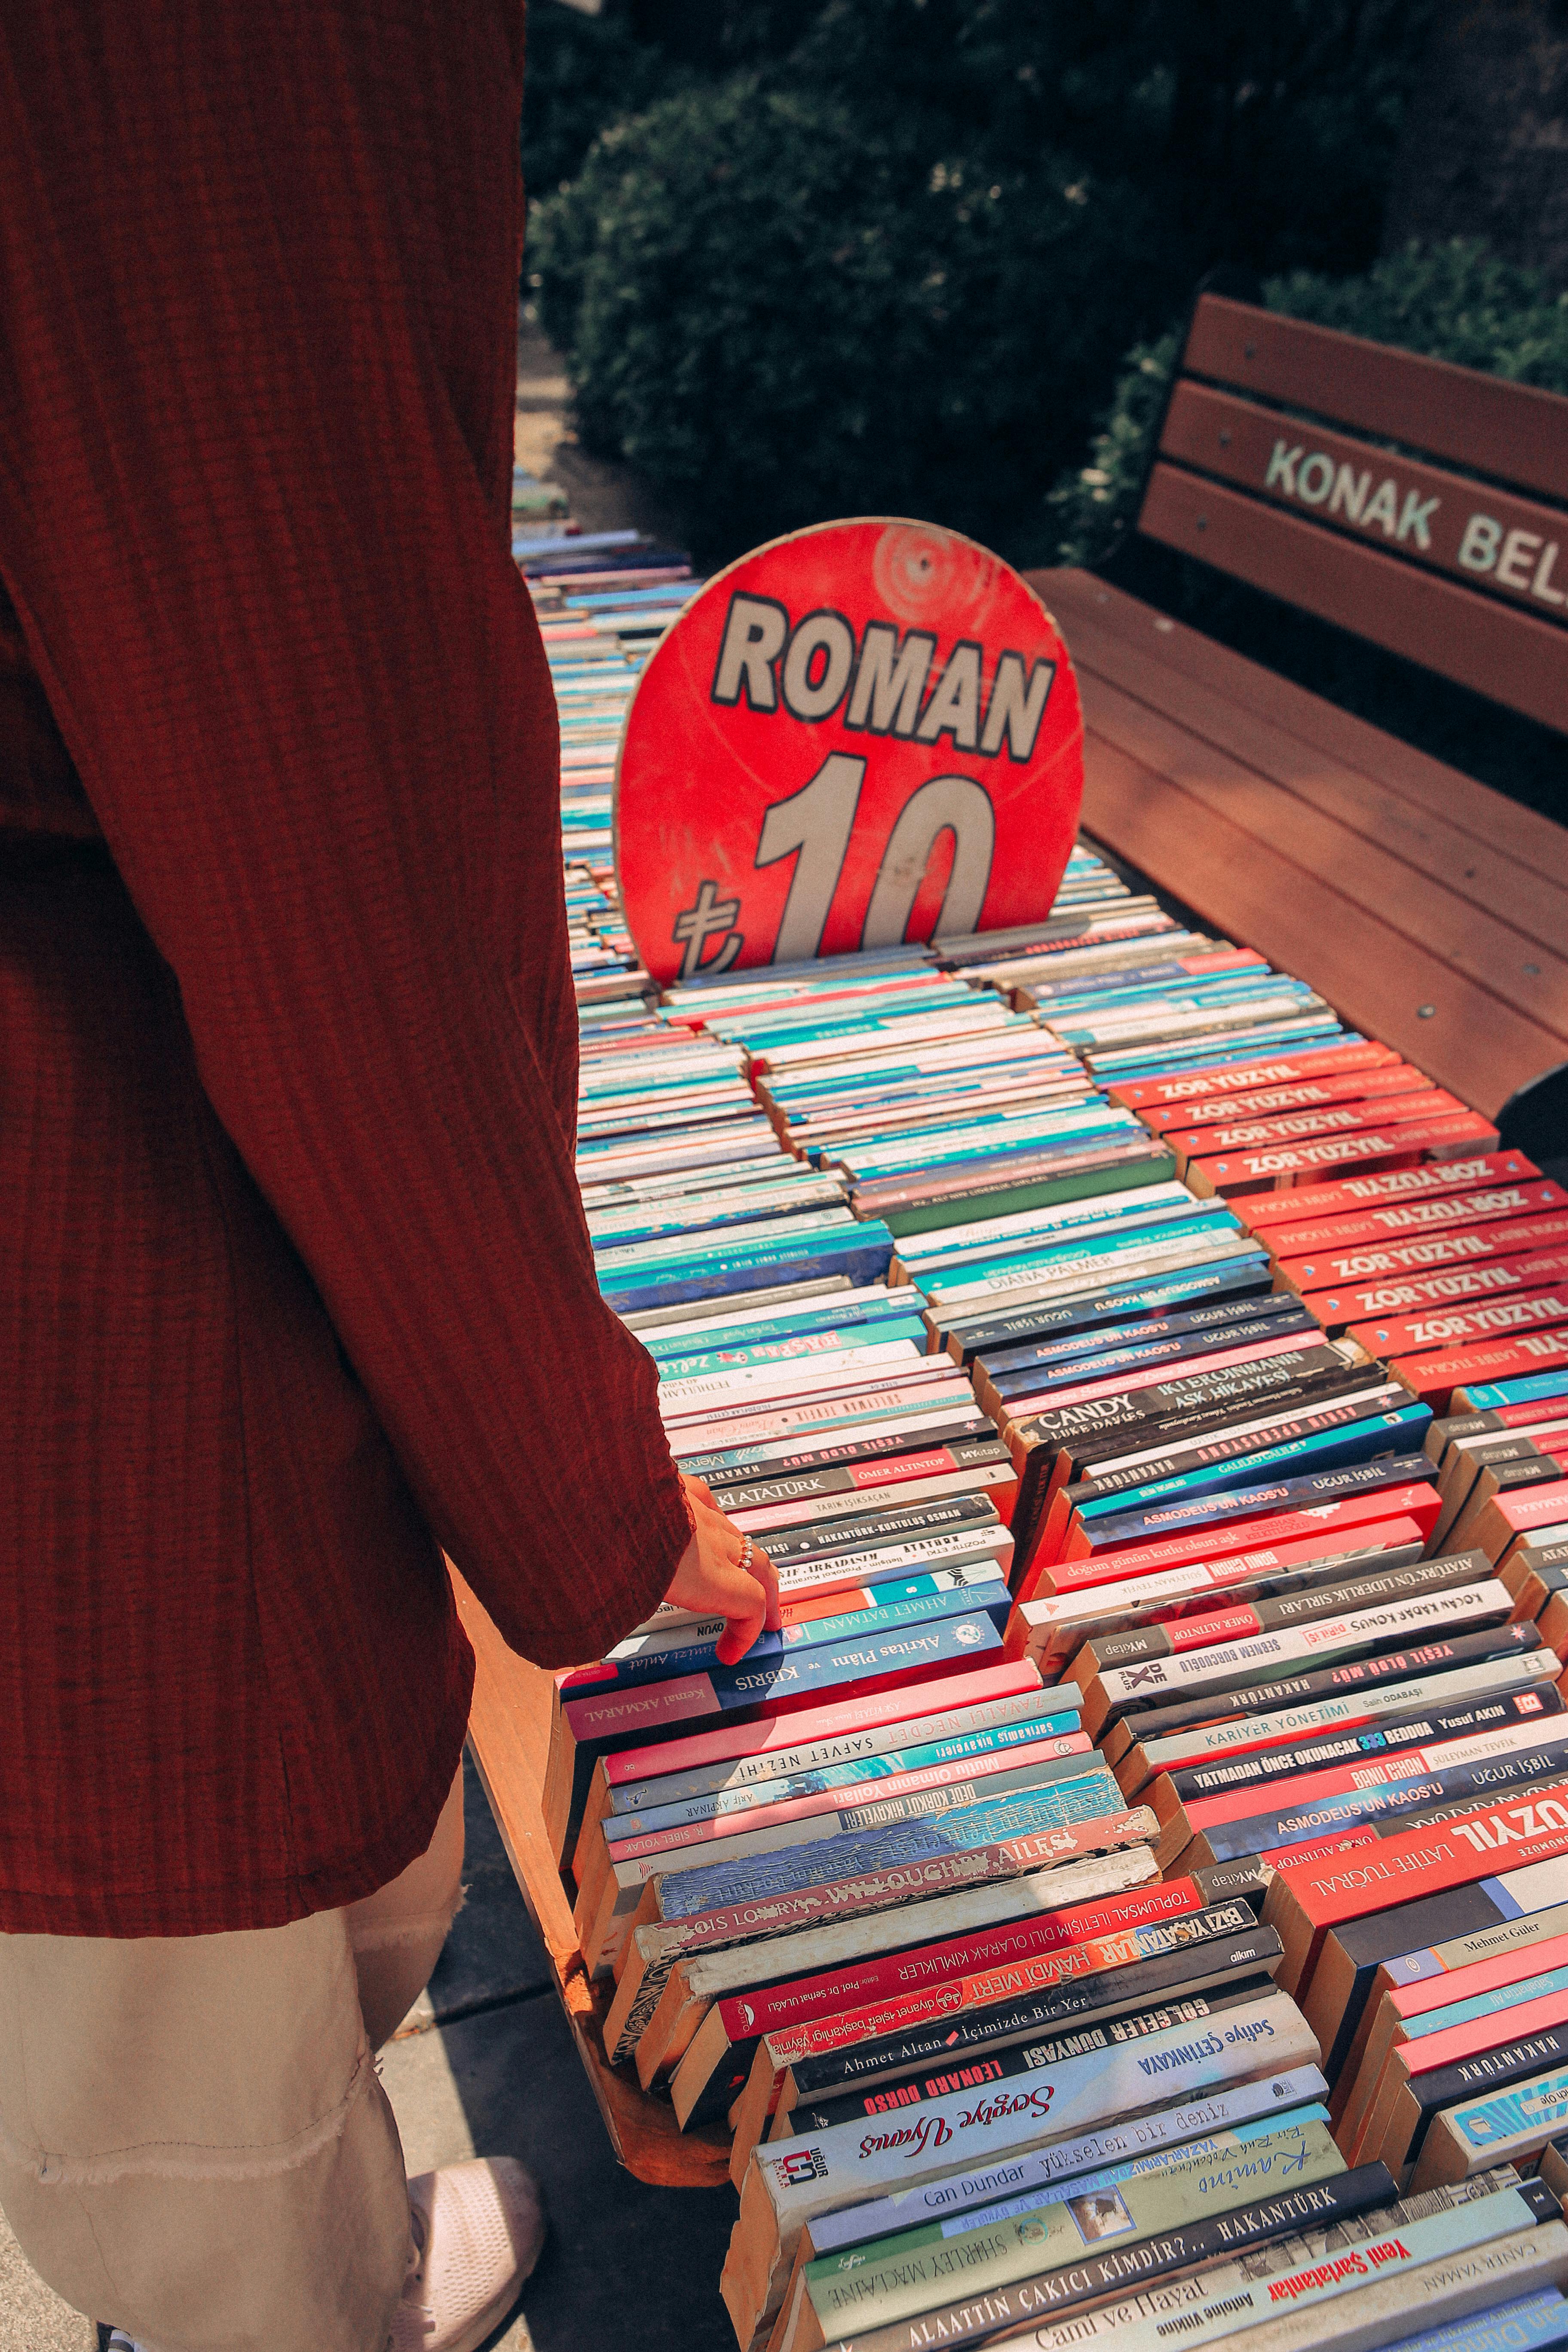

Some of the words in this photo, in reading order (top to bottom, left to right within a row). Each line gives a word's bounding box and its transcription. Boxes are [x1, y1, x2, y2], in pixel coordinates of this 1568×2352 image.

[1265, 438, 1440, 549] KONAK
[1458, 514, 1568, 605] BEL
[710, 590, 1056, 763] ROMAN
[754, 751, 995, 964] 10
[1157, 1075, 1215, 1103] ZOR
[1183, 1096, 1243, 1125] ZOR
[1212, 1120, 1273, 1148] ZOR
[1242, 1148, 1304, 1177] ZOR
[1433, 1156, 1494, 1185] ZOR
[1467, 1187, 1528, 1214] ZOR
[1331, 1248, 1396, 1282] ZOR
[1355, 1280, 1422, 1314] ZOR
[1404, 1310, 1474, 1347] ZOR
[1036, 1392, 1136, 1433] CANDY
[1050, 1423, 1088, 1440] LUKE
[1196, 1422, 1302, 1461] OPERASYONU
[781, 1453, 814, 1468] MÜ?
[819, 1444, 857, 1461] ÖLDÜ
[736, 1472, 826, 1506] ATATÜRK
[857, 1464, 892, 1482] ÖMER
[892, 1454, 945, 1474] ALTINTOP
[960, 1442, 1001, 1462] MYkitap
[1092, 1458, 1176, 1494] HAKANTÜRK
[1238, 1485, 1290, 1507] KAOS'U
[1312, 1471, 1352, 1491] UĞUR
[1352, 1463, 1387, 1483] İŞBİL
[815, 1499, 842, 1513] TARIK
[926, 1507, 961, 1522] OSMAN
[1066, 1558, 1110, 1580] doğum
[1110, 1551, 1151, 1571] günün
[1151, 1542, 1184, 1560] kutlu
[1184, 1534, 1217, 1553] olsun
[1218, 1531, 1240, 1547] aşk
[1207, 1556, 1246, 1579] CİHAN
[1243, 1549, 1278, 1570] BANU
[821, 1564, 861, 1580] Protokol
[1394, 1557, 1474, 1589] ATATÜRK'ÜN
[1279, 1592, 1334, 1616] SIRLARI
[1332, 1576, 1395, 1603] LİDERLİK
[822, 1607, 891, 1631] BATMAN
[893, 1595, 948, 1616] AHMET
[1397, 1601, 1439, 1621] KADAR
[695, 1621, 725, 1638] OYUN
[1173, 1620, 1222, 1641] ALTINTOP
[1222, 1613, 1253, 1630] ÖMER
[830, 1648, 878, 1672] Plânı
[879, 1633, 941, 1660] Akritas
[1104, 1635, 1148, 1659] MYkitap
[1179, 1647, 1238, 1675] BURCUOĞLU
[1238, 1637, 1280, 1660] ŞEBNEM
[1409, 1641, 1454, 1666] YEŞİL
[734, 1664, 800, 1692] KIBRIS
[807, 1660, 821, 1670] ve
[1330, 1665, 1364, 1684] MÜ?
[1367, 1654, 1407, 1676] ÖLDÜ
[1118, 1671, 1132, 1691] PLUS
[1228, 1678, 1311, 1710] HAKANTÜRK
[584, 1698, 660, 1722] AKMARAL
[663, 1688, 705, 1706] Kemal
[885, 1714, 961, 1746] NECDET
[1204, 1717, 1272, 1746] KARİYER
[1275, 1700, 1349, 1730] YÖNETİMİ
[1382, 1686, 1423, 1704] ODABAŞI
[808, 1735, 873, 1763] SAFVET
[934, 1736, 994, 1759] hikayeleri
[1193, 1759, 1263, 1791] YATMADAN
[1259, 1749, 1297, 1775] ÖNCE
[1293, 1737, 1362, 1767] OKUNACAK
[1384, 1720, 1434, 1746] BEDDUA
[1436, 1710, 1474, 1732] Yusuf
[1474, 1703, 1507, 1723] AKIN
[886, 1767, 952, 1794] Olmanın
[955, 1756, 1001, 1777] Mutlu
[1350, 1764, 1388, 1790] BANU
[1384, 1754, 1427, 1783] CİHAN
[1471, 1761, 1518, 1787] UĞUR
[1516, 1750, 1556, 1776] İŞBİL
[832, 1783, 885, 1807] Yolları
[904, 1789, 949, 1814] KORKUT
[948, 1782, 977, 1804] DEDE
[685, 1799, 730, 1818] AKPINAR
[843, 1800, 906, 1829] HİKAYELERİ
[623, 1837, 660, 1853] YOLAK
[660, 1830, 690, 1846] SİBEL
[692, 1826, 703, 1836] R.
[1274, 1845, 1335, 1870] ALTINTOP
[1391, 1838, 1456, 1878] LATİFE
[1309, 1856, 1396, 1904] TUĞRAL
[1111, 1890, 1190, 1923] TOPLUMSAL
[1204, 1904, 1244, 1934] BİZİ
[1028, 1926, 1056, 1947] DİLİ
[1055, 1909, 1112, 1940] İLETİŞİM
[1462, 1930, 1510, 1953] Mehmet
[1508, 1921, 1541, 1939] Güler
[969, 1933, 1028, 1961] OLARAK
[1097, 1915, 1207, 1965] YAŞATANLAR
[1228, 1946, 1256, 1963] alkım
[897, 1949, 970, 1983] KİMLİKLER
[1024, 1948, 1092, 1987] HAMDİ
[799, 1989, 827, 2004] Serhat
[827, 1986, 839, 1996] Dr.
[840, 1980, 860, 1993] Prof.
[968, 1970, 1023, 2001] MERT
[1489, 1992, 1504, 2006] Ali
[1503, 1975, 1555, 2001] Sabahattin
[767, 1996, 799, 2014] ULAĞLI
[895, 1996, 935, 2017] diyanet
[842, 2049, 894, 2073] Ahmet
[899, 2036, 942, 2057] Altan
[961, 2008, 1030, 2043] İçimizde
[1032, 2003, 1057, 2020] Bir
[1060, 1995, 1087, 2012] Yer
[1222, 2015, 1275, 2049] Safiye
[1022, 2028, 1108, 2068] DÜNYASI
[1135, 2030, 1226, 2080] ÇETİNKAYA
[1456, 2031, 1562, 2088] HAKANTÜRK
[923, 2058, 1004, 2098] LEONARD
[862, 2083, 921, 2116] DURSO
[954, 2081, 1060, 2138] Sevgiye
[853, 2110, 956, 2170] Uyanış
[923, 2186, 958, 2209] Can
[961, 2163, 1027, 2196] Dündar
[1037, 2130, 1130, 2179] yükselen
[1131, 2117, 1168, 2144] bir
[1173, 2098, 1229, 2131] deniz
[810, 2147, 829, 2178] UĞUR
[1100, 2137, 1219, 2185] YAZARLARIMIZDAN
[1198, 2141, 1312, 2194] Kamino
[1032, 2174, 1101, 2207] MASALLAR
[1011, 2197, 1030, 2214] VE
[905, 2292, 1012, 2349] ALAATTİN
[1017, 2266, 1094, 2312] ÇAKICI
[1096, 2225, 1207, 2284] KİMDİR?..
[1215, 2179, 1338, 2243] HAKANTÜRK
[928, 2233, 1008, 2277] SHIRLEY
[1365, 2236, 1412, 2271] Yeni
[1480, 2242, 1537, 2272] CANER
[826, 2260, 927, 2310] MACLAINE
[1265, 2248, 1369, 2306] Şarlatanlar
[1423, 2260, 1482, 2291] YAMAN
[1032, 2312, 1099, 2352] Cami
[1102, 2303, 1133, 2329] ve
[1133, 2274, 1210, 2318] Hayat
[1202, 2291, 1255, 2325] Antoine
